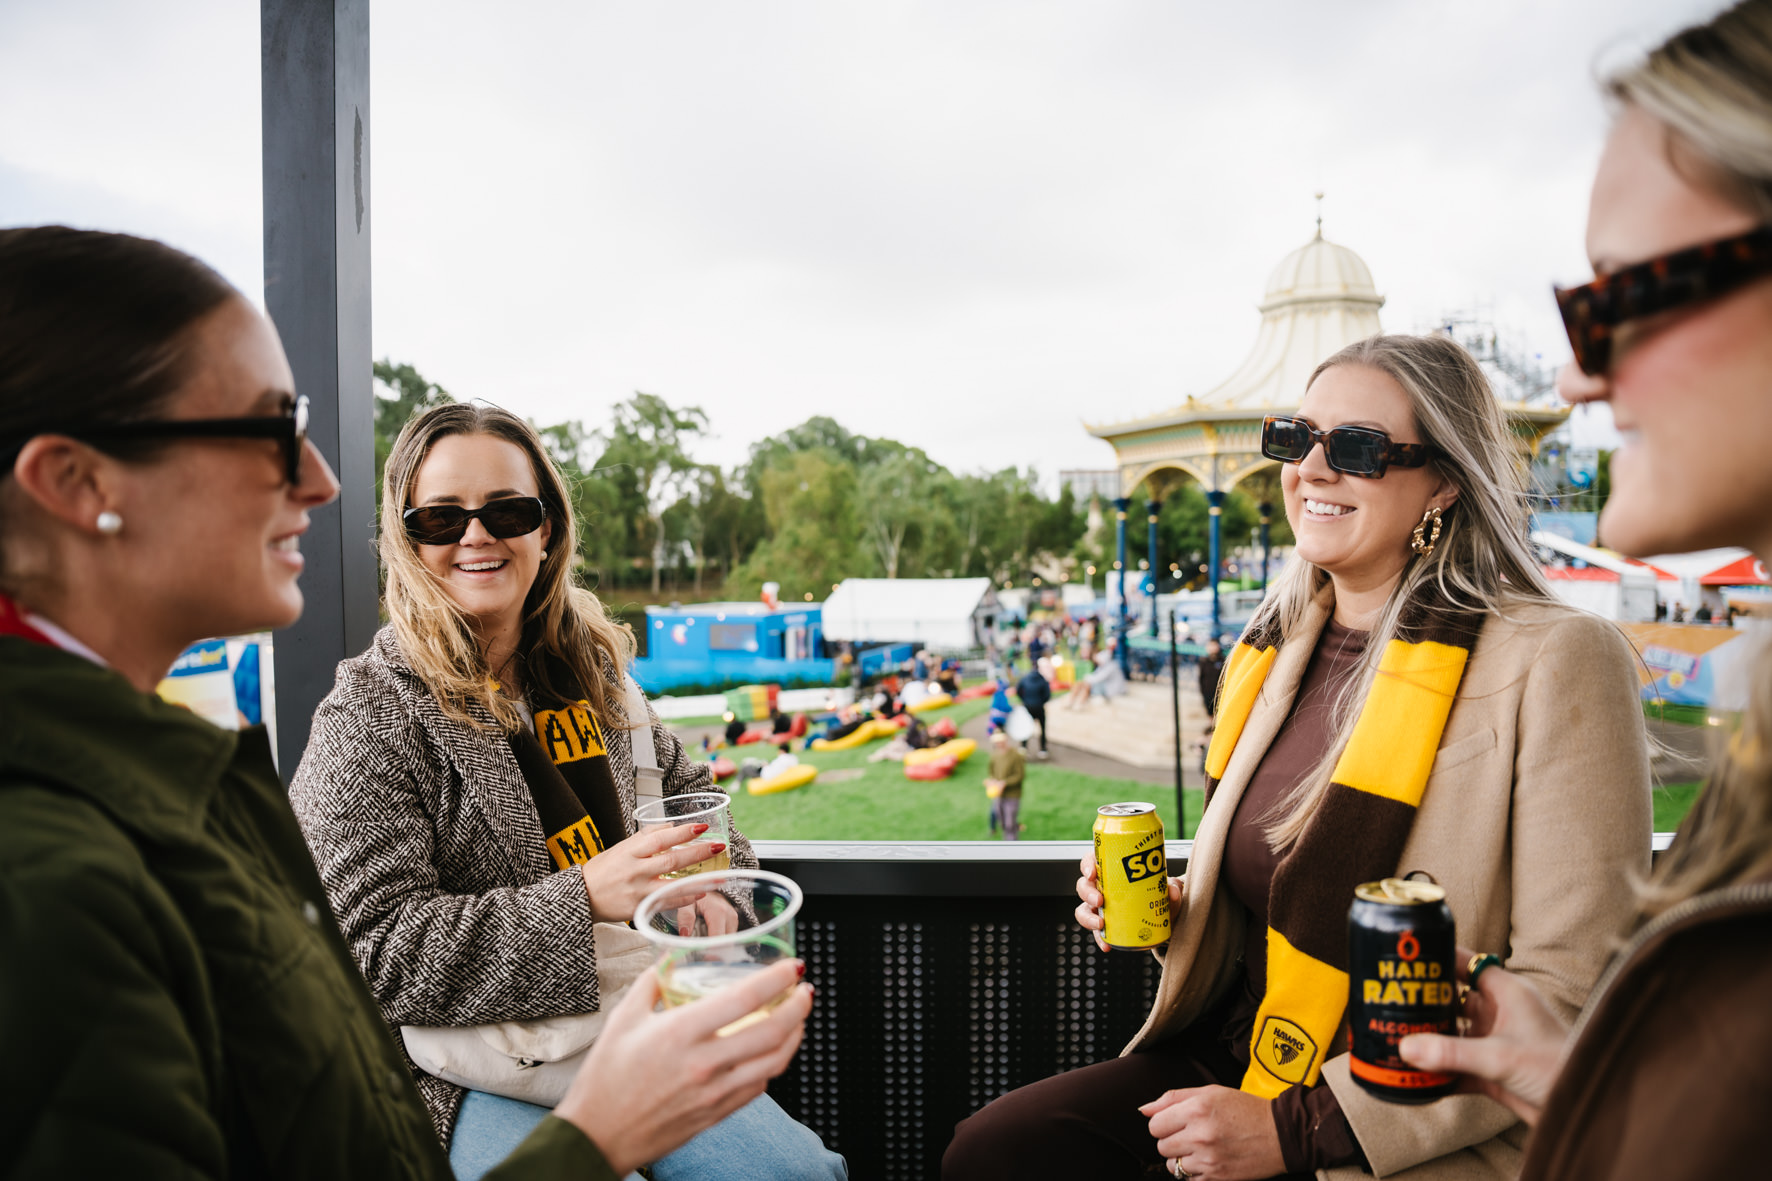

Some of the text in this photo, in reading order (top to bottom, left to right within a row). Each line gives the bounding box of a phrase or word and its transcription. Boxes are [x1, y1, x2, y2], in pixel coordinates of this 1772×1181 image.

[1378, 960, 1442, 979] HARD
[1362, 979, 1454, 1006] RATED
[1273, 1027, 1305, 1051] HAWKS
